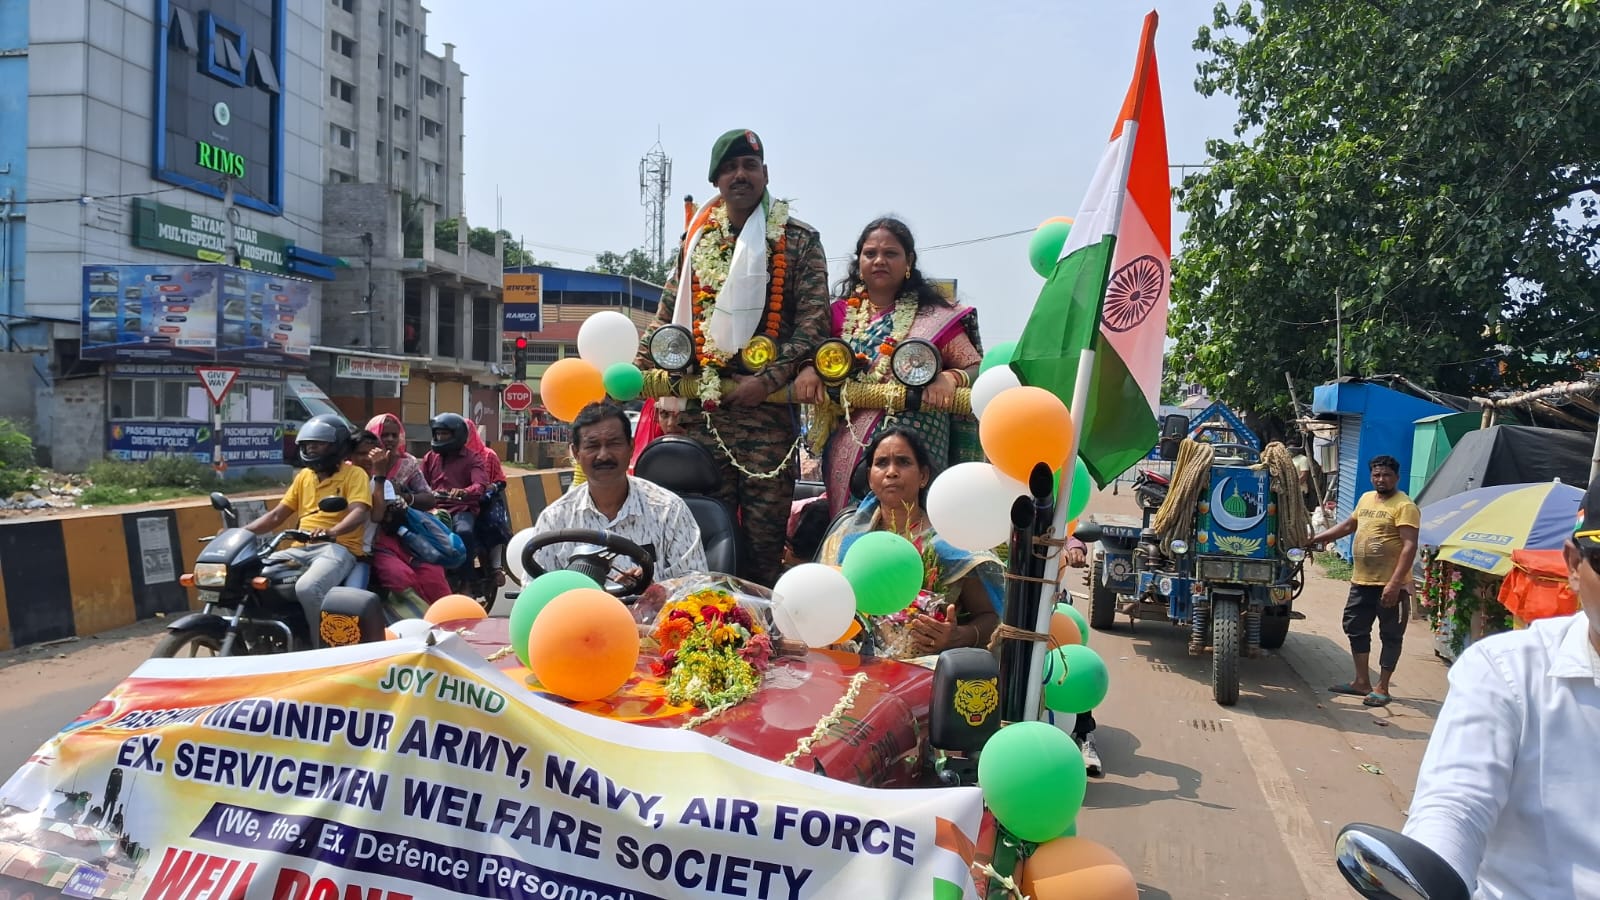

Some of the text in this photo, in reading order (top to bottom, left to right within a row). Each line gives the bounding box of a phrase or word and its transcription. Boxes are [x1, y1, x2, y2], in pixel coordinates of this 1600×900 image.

[198, 141, 245, 178] RIMS
[158, 223, 242, 255] MULTISPECIALY
[244, 245, 283, 266] HOSPITAL
[207, 371, 227, 379] GIVE
[208, 379, 226, 387] WAY
[131, 436, 189, 447] DISTRICT POLICE
[228, 437, 269, 446] DISTRICT POLICE
[245, 451, 258, 459] HELP
[259, 450, 269, 459] YOU
[380, 665, 506, 713] JOY HIND
[203, 699, 393, 750] MEDINIPUR
[399, 719, 529, 787] ARMY,
[544, 756, 664, 828] NAVY,
[679, 798, 760, 836] AIR
[774, 805, 916, 865] FORCE
[117, 737, 813, 900] EX. SERVICEMEN WELFARE SOCIETY
[216, 807, 262, 842] (We,
[267, 818, 306, 849] the,
[317, 823, 346, 855] Ex.
[355, 833, 470, 879] Defence
